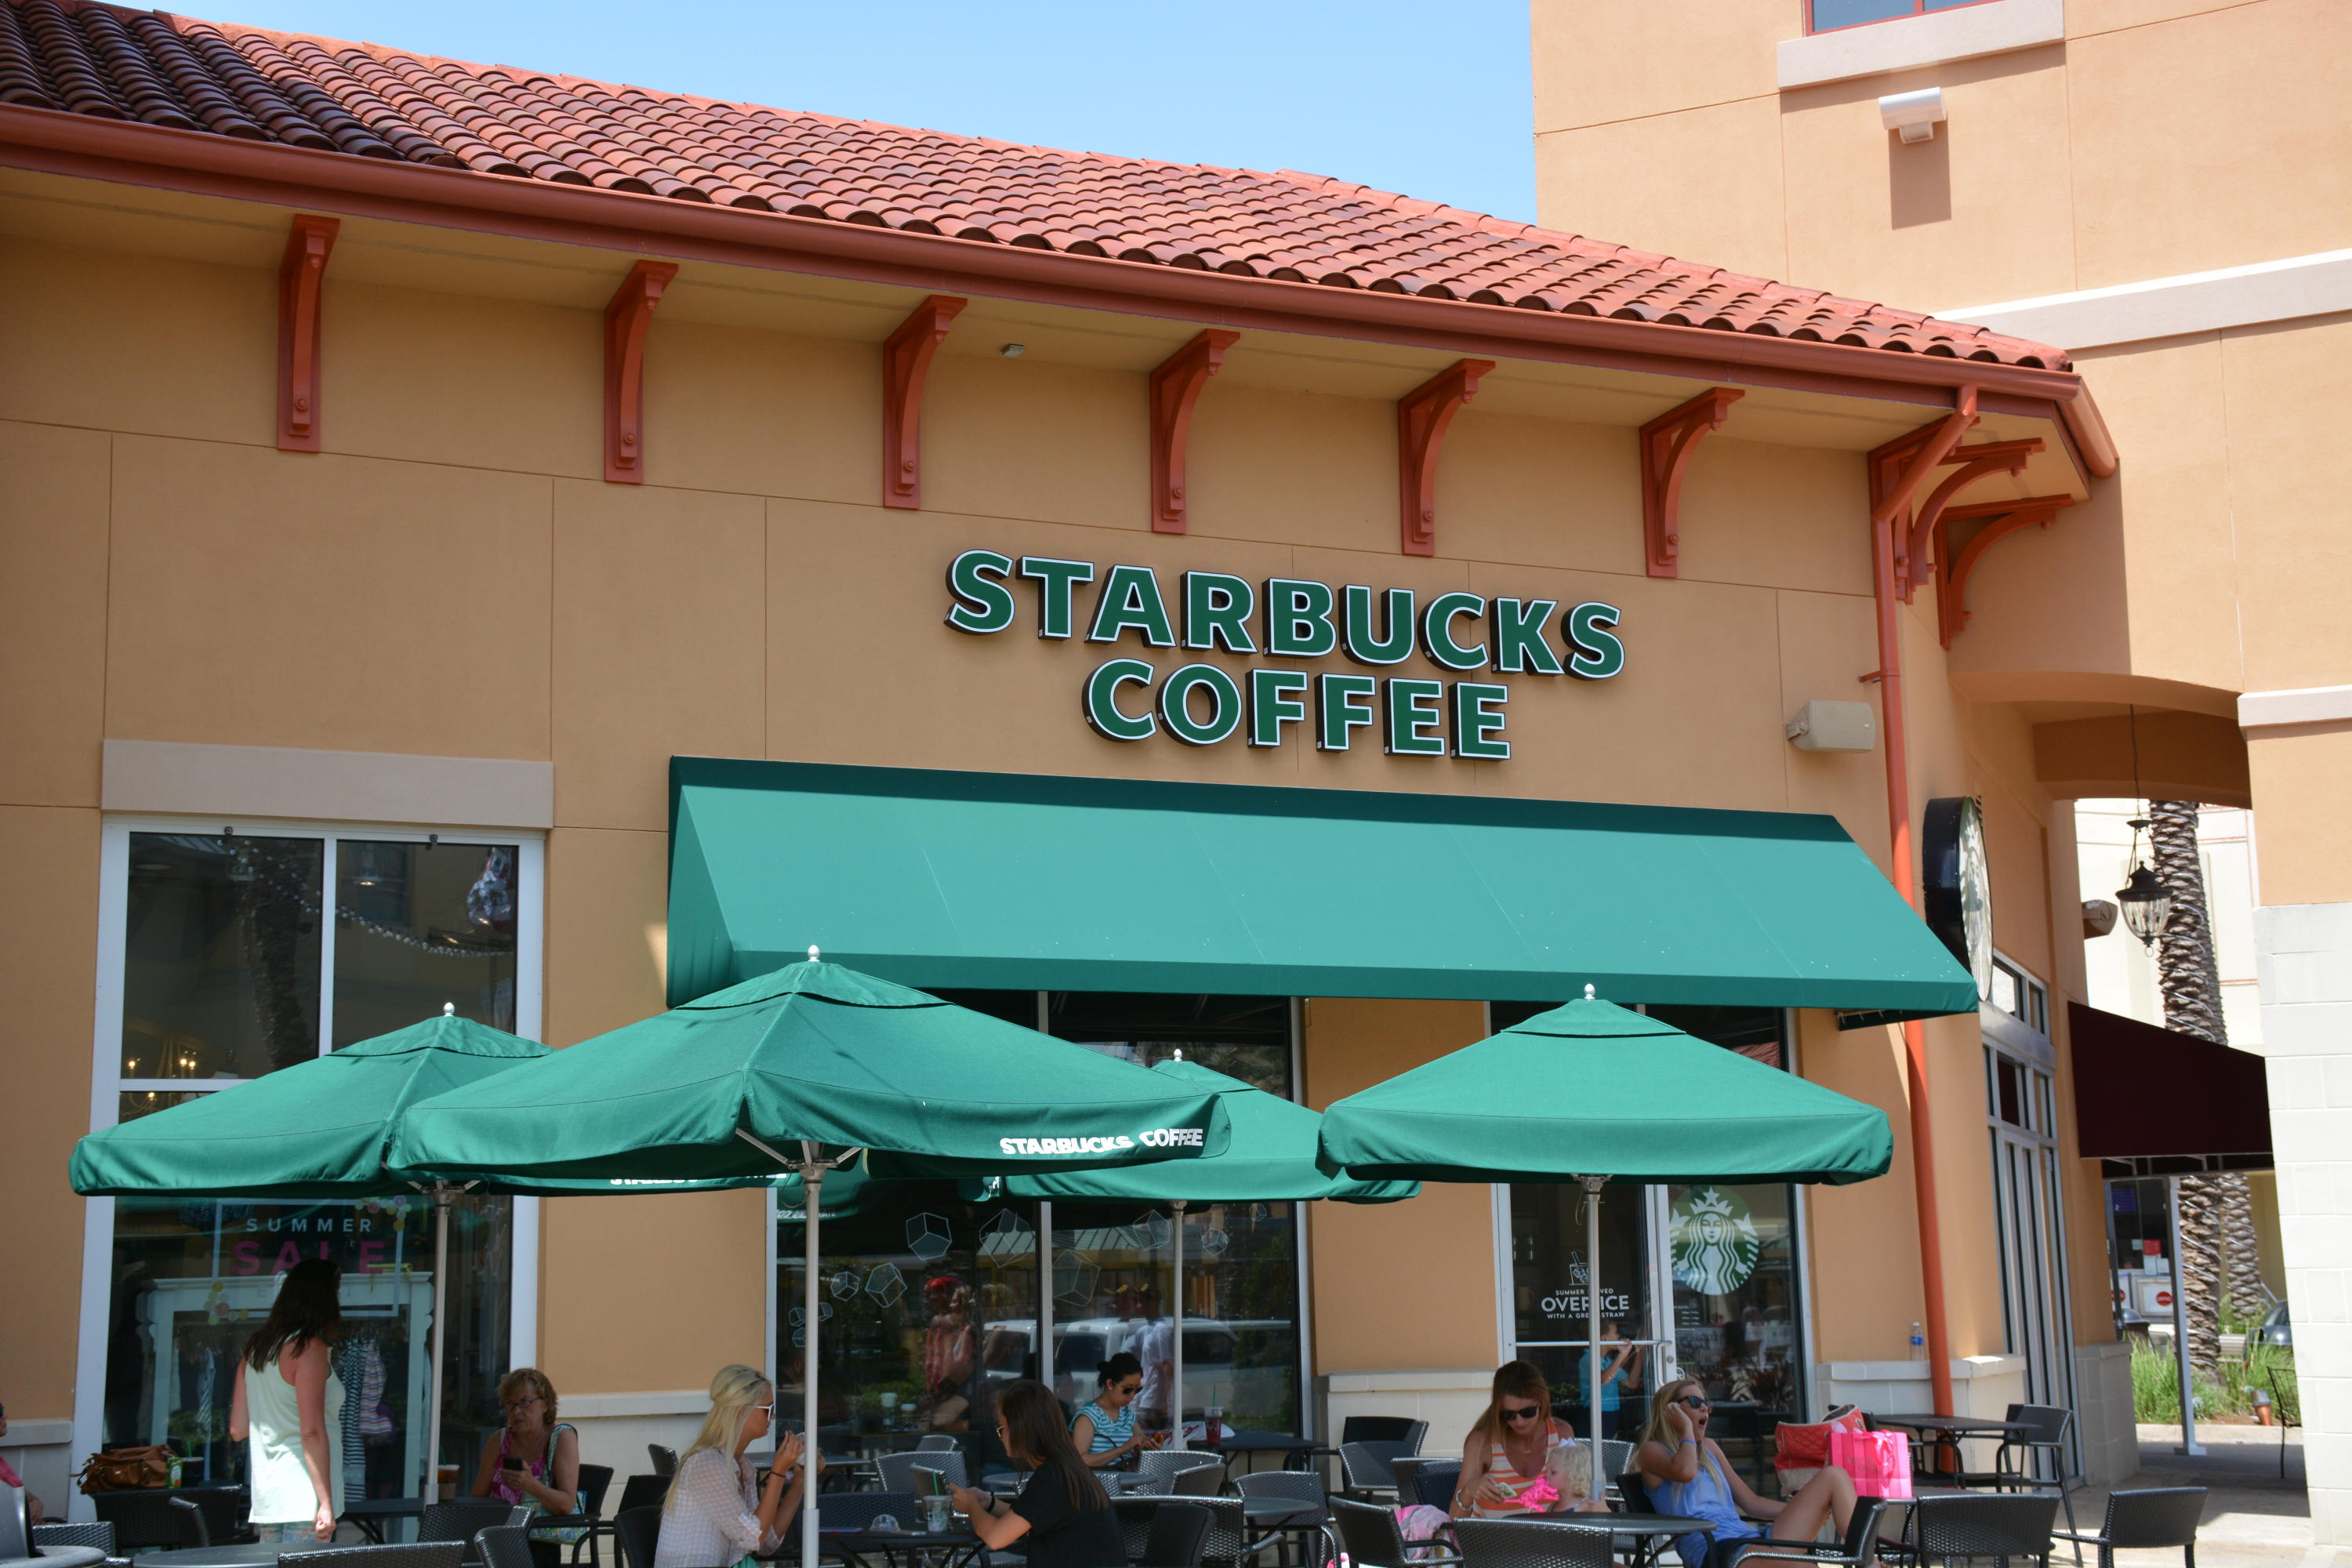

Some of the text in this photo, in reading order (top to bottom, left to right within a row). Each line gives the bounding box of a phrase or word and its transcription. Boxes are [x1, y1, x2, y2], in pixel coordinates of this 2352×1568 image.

[946, 549, 1625, 680] STARBUCKS
[1084, 657, 1512, 760] COFFEE
[1000, 1128, 1203, 1155] STARBUCKS COFFEE
[246, 1218, 371, 1232] SUMMER
[1600, 1295, 1630, 1311] ICE
